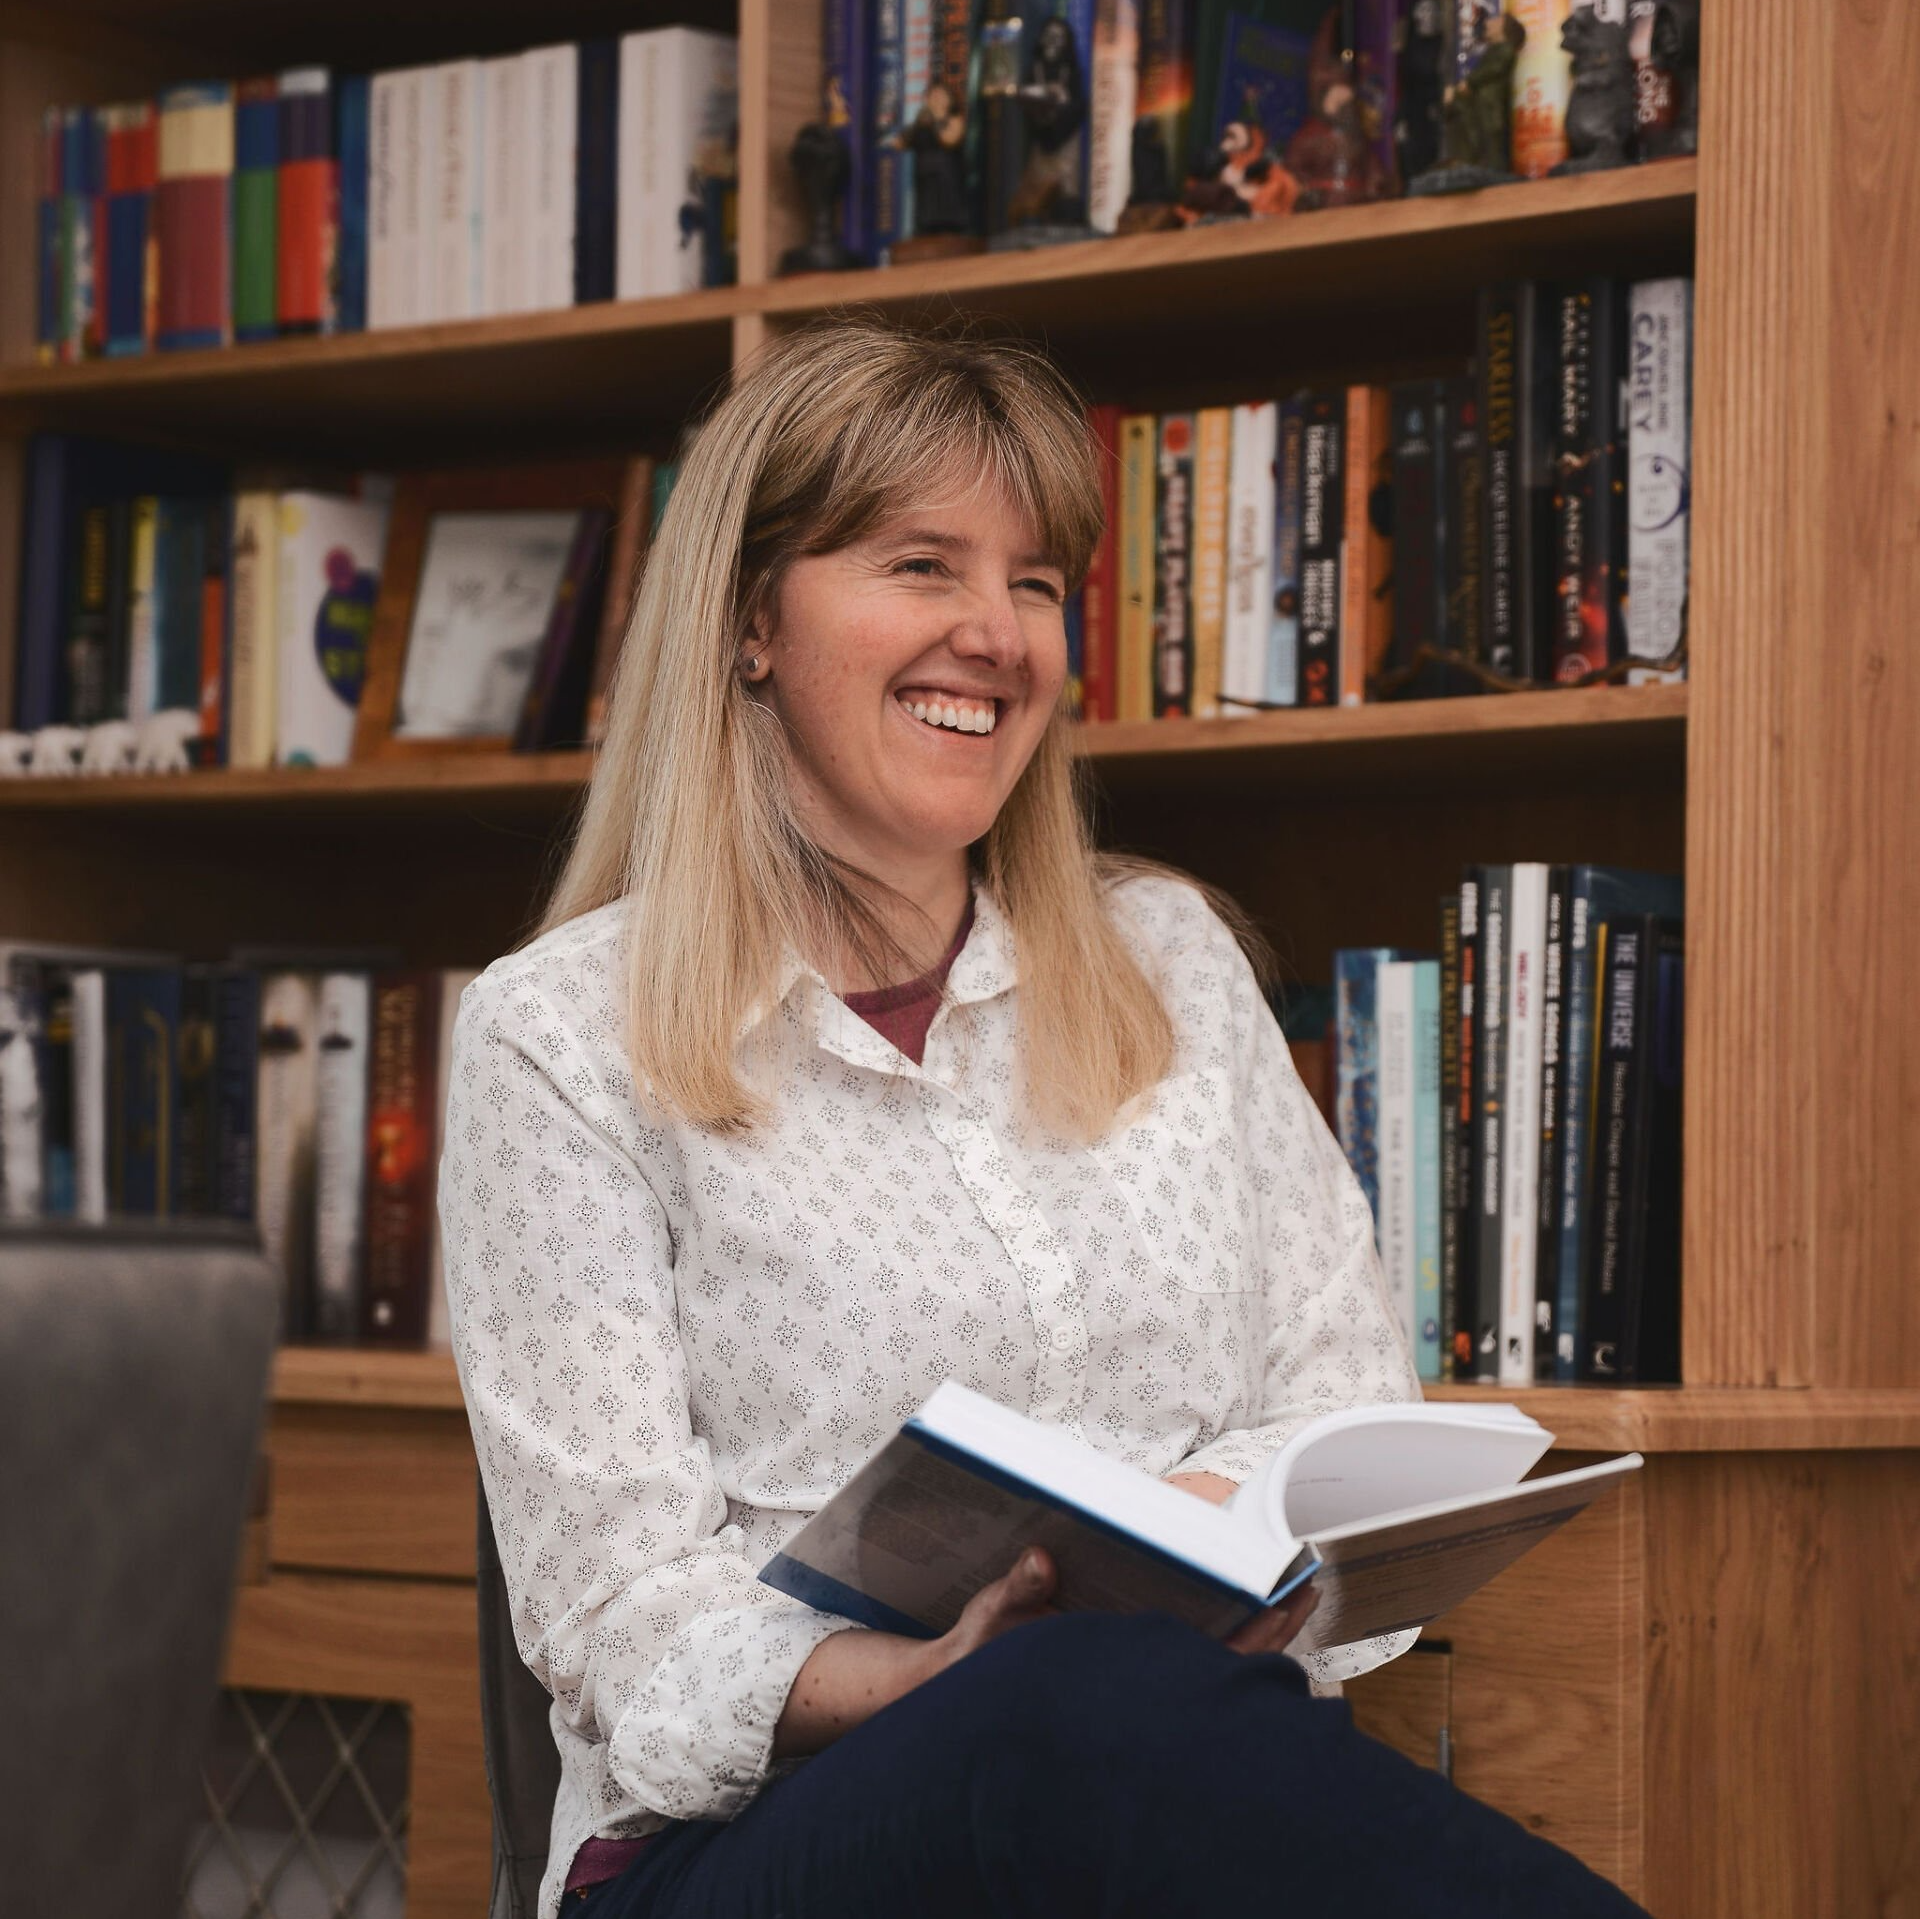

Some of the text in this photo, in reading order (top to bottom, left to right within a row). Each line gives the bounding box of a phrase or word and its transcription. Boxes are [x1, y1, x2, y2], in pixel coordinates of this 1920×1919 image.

[1638, 59, 1658, 123] LONG
[1488, 311, 1515, 444] STARLESS
[1561, 296, 1577, 437] HAIL MARY
[1633, 312, 1654, 433] CAREY
[1304, 424, 1327, 547] blackman
[1566, 494, 1583, 639] ANDY WEIR
[1489, 888, 1502, 911] THE
[1516, 950, 1529, 1019] MELODY
[1546, 942, 1560, 998] WRITE
[1610, 932, 1638, 1050] THE UNIVERSE
[1545, 1001, 1560, 1064] SONGS
